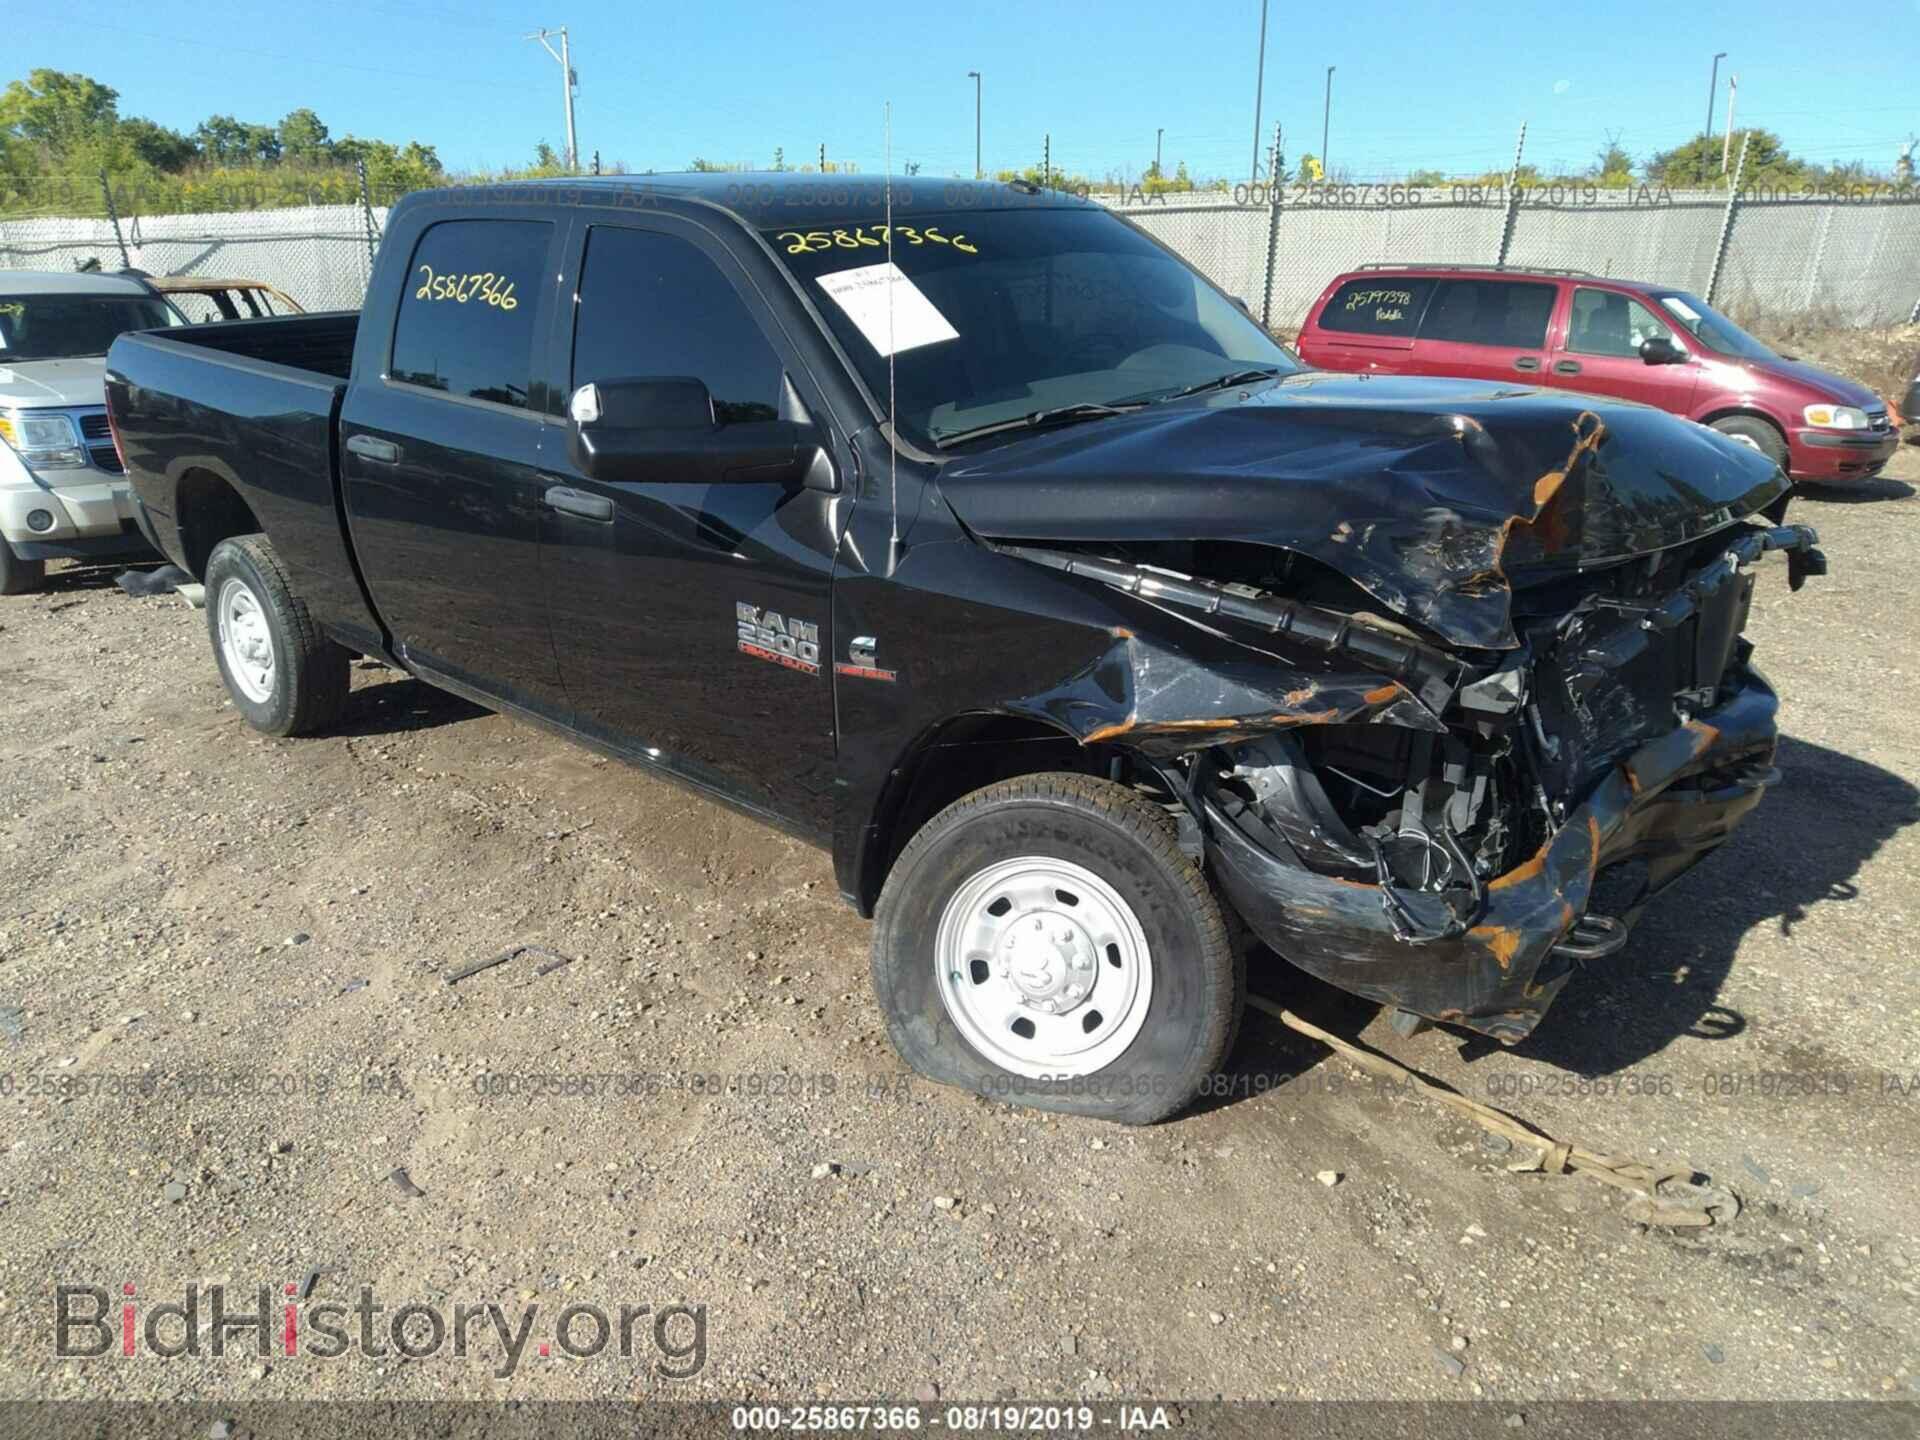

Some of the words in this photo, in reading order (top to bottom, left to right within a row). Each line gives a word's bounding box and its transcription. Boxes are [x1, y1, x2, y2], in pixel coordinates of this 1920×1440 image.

[776, 225, 979, 254] 25867366
[416, 264, 518, 309] 25867366
[736, 601, 819, 644] RAM
[737, 620, 820, 664] 2500
